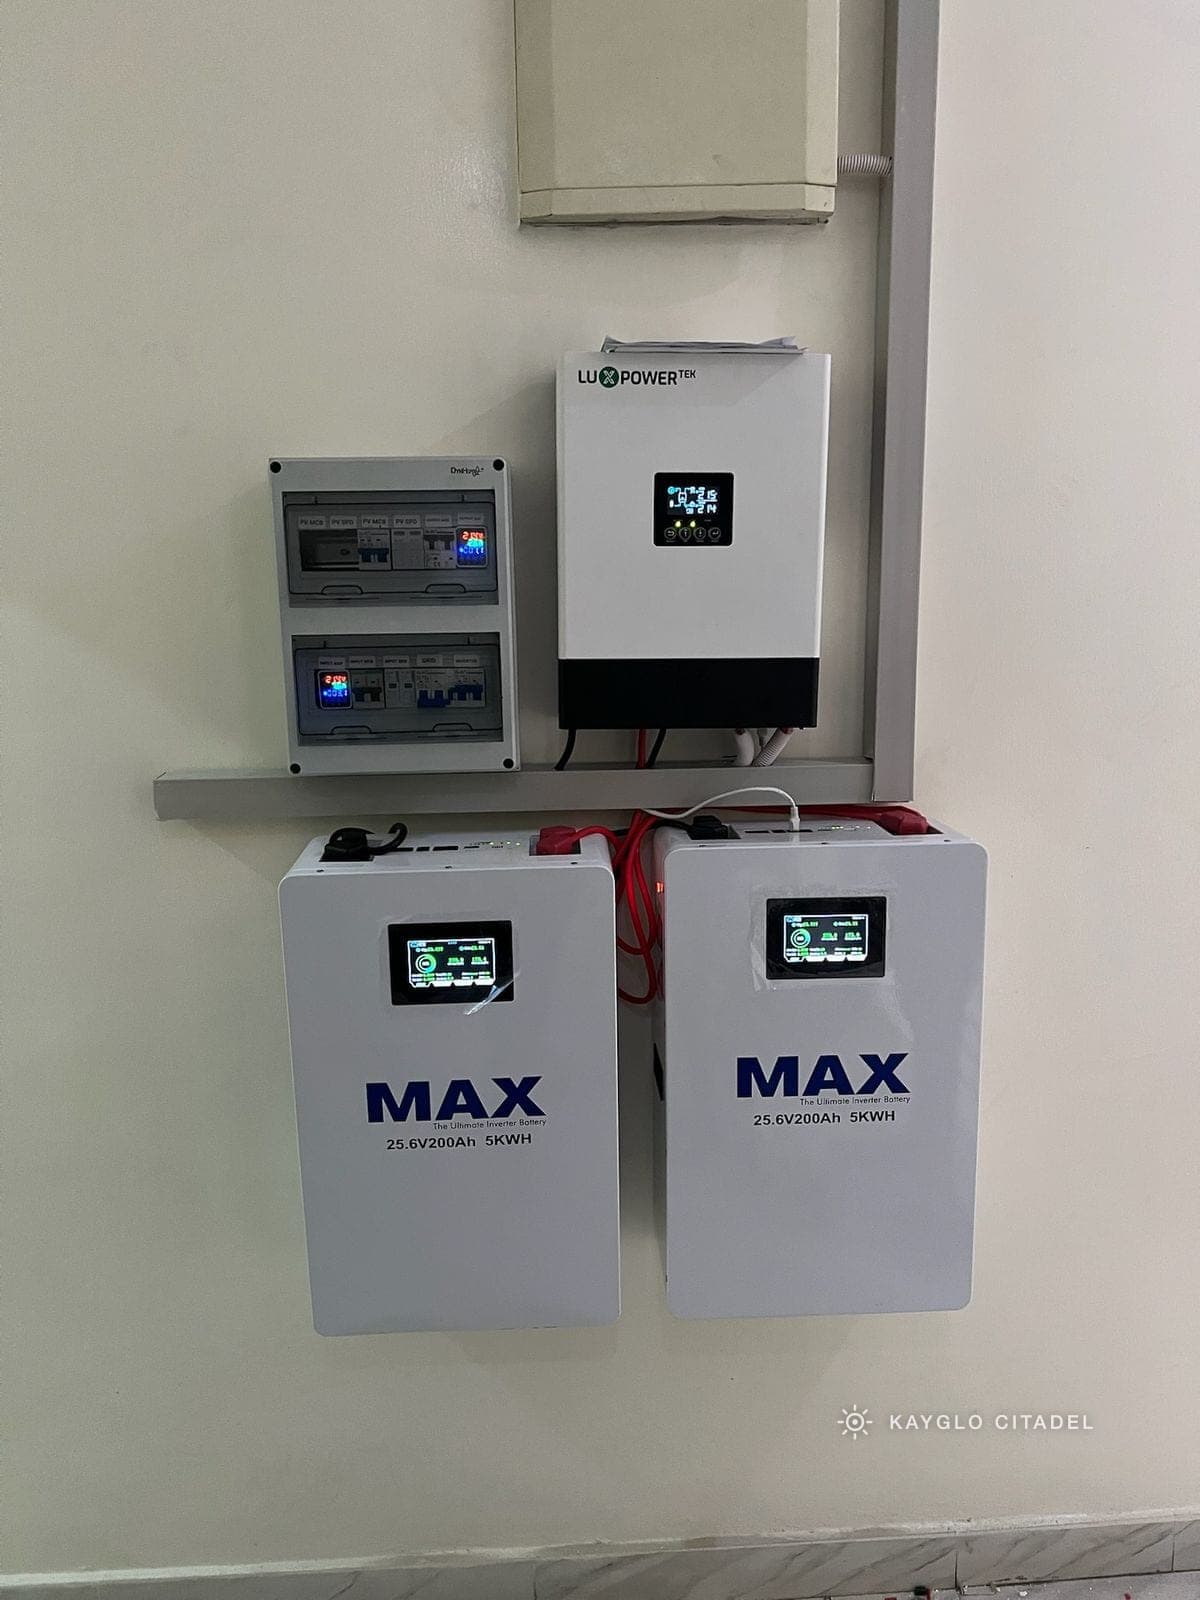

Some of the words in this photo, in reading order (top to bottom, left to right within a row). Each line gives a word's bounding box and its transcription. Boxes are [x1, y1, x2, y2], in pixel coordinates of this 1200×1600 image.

[736, 1053, 911, 1098] MAX
[365, 1076, 547, 1123] MAX
[800, 1098, 814, 1106] The
[816, 1097, 850, 1106] Ultimate
[852, 1096, 882, 1104] Inverter
[883, 1095, 911, 1104] Battery
[433, 1122, 448, 1130] The
[450, 1121, 485, 1130] Ultimate
[486, 1119, 517, 1128] Inverter
[519, 1118, 547, 1127] Battery
[753, 1112, 841, 1126] 25.6V200Ah
[849, 1110, 896, 1123] 5KWH
[386, 1136, 476, 1150] 25.6V200Ah
[485, 1133, 532, 1146] 5KWH
